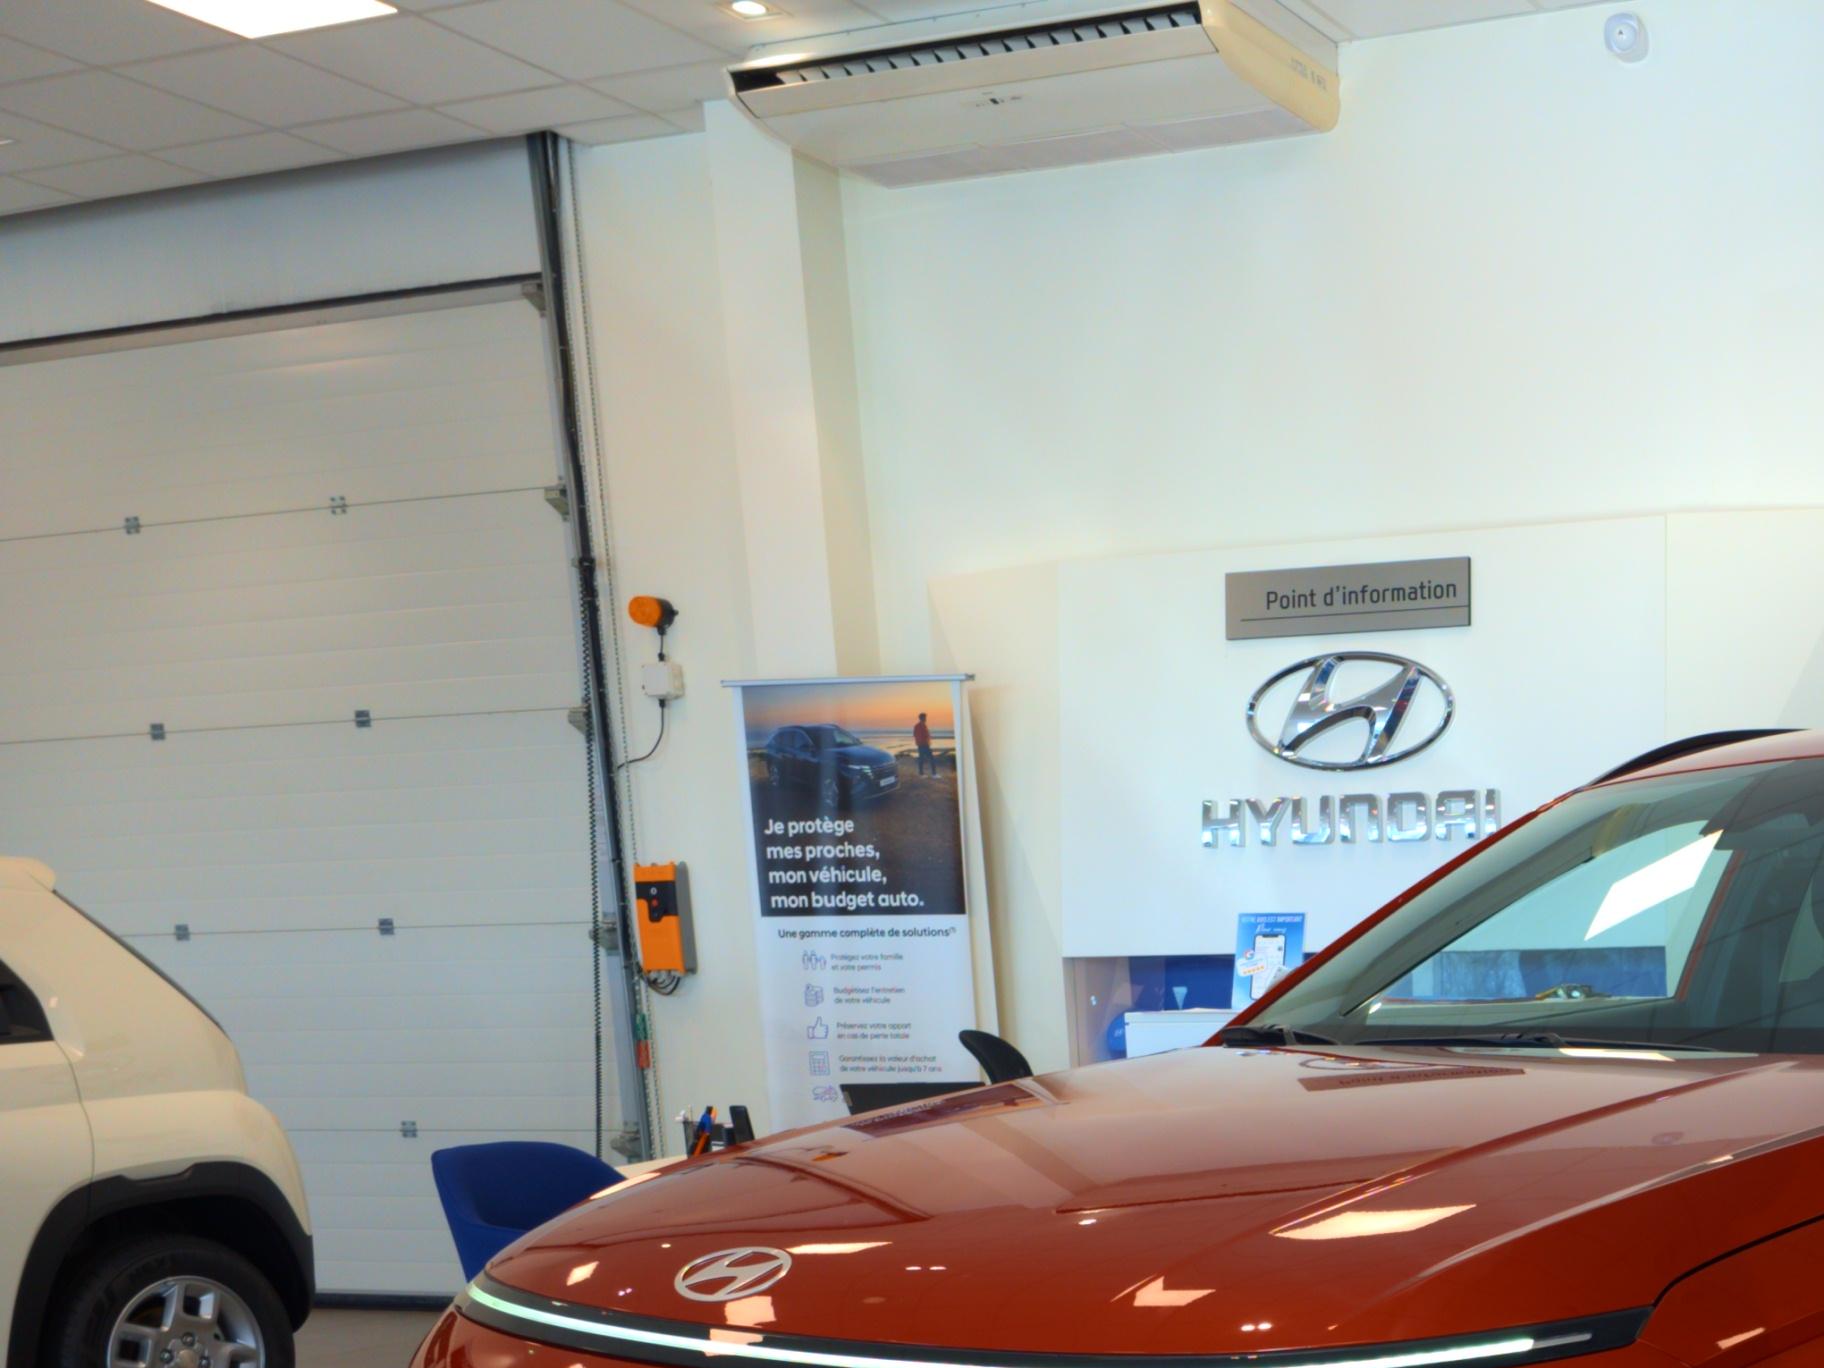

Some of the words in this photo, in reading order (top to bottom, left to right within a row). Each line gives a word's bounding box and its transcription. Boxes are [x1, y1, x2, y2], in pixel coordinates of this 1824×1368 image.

[1265, 588, 1317, 611] Point
[1323, 580, 1458, 607] d'information
[764, 818, 785, 836] Je
[788, 816, 855, 837] protège
[1200, 787, 1503, 849] HYUNDAI
[766, 844, 803, 860] mes
[805, 841, 881, 862] proches,
[768, 868, 807, 884] mon
[810, 865, 888, 885] véhicule,
[770, 893, 809, 909] mon
[811, 890, 875, 911] budget
[878, 889, 925, 908] auto.
[778, 928, 798, 939] Une
[799, 929, 839, 941] gamme
[839, 926, 886, 942] complète
[887, 928, 901, 939] de
[834, 996, 844, 1004] de
